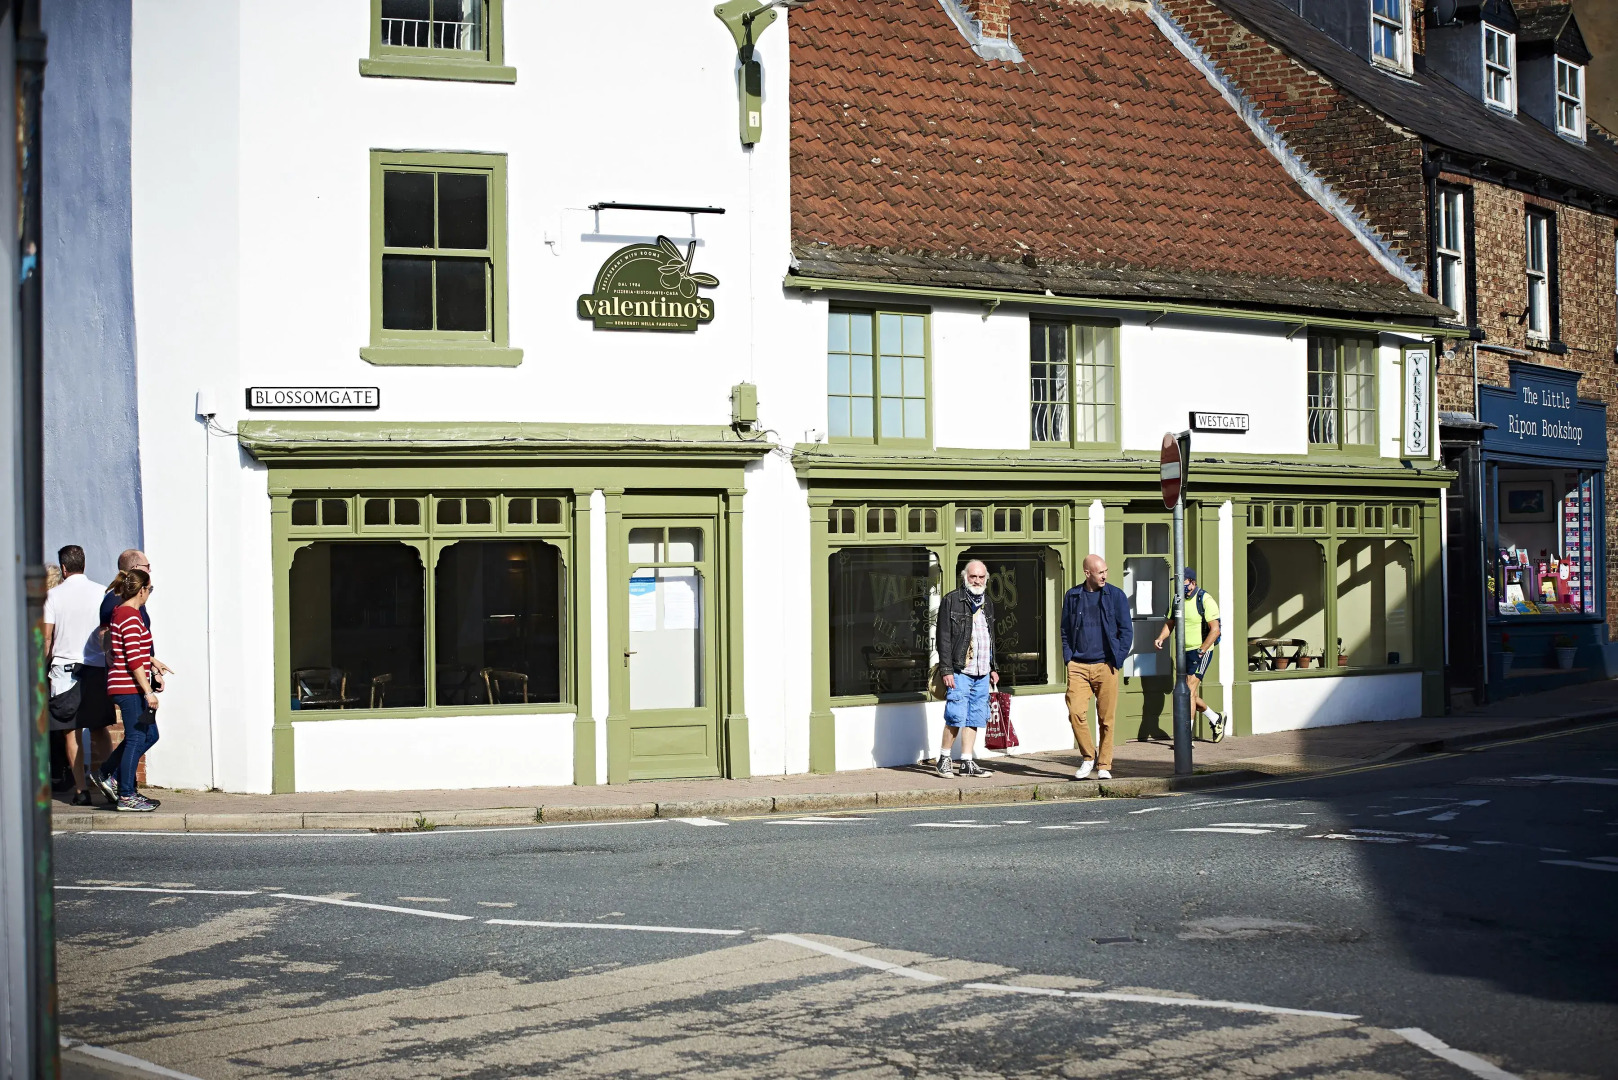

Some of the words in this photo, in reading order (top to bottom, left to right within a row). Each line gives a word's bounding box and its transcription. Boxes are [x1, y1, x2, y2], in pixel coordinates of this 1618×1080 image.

[583, 296, 710, 319] valentino's
[256, 390, 373, 404] BLOSSOMGATE
[1412, 357, 1422, 448] VALENTINOS
[1522, 386, 1539, 405] The
[1541, 389, 1570, 409] Little
[1198, 415, 1246, 428] WESTGATE
[1508, 413, 1537, 440] Ripon
[1541, 419, 1583, 446] Bookshop
[997, 612, 1018, 636] CASA
